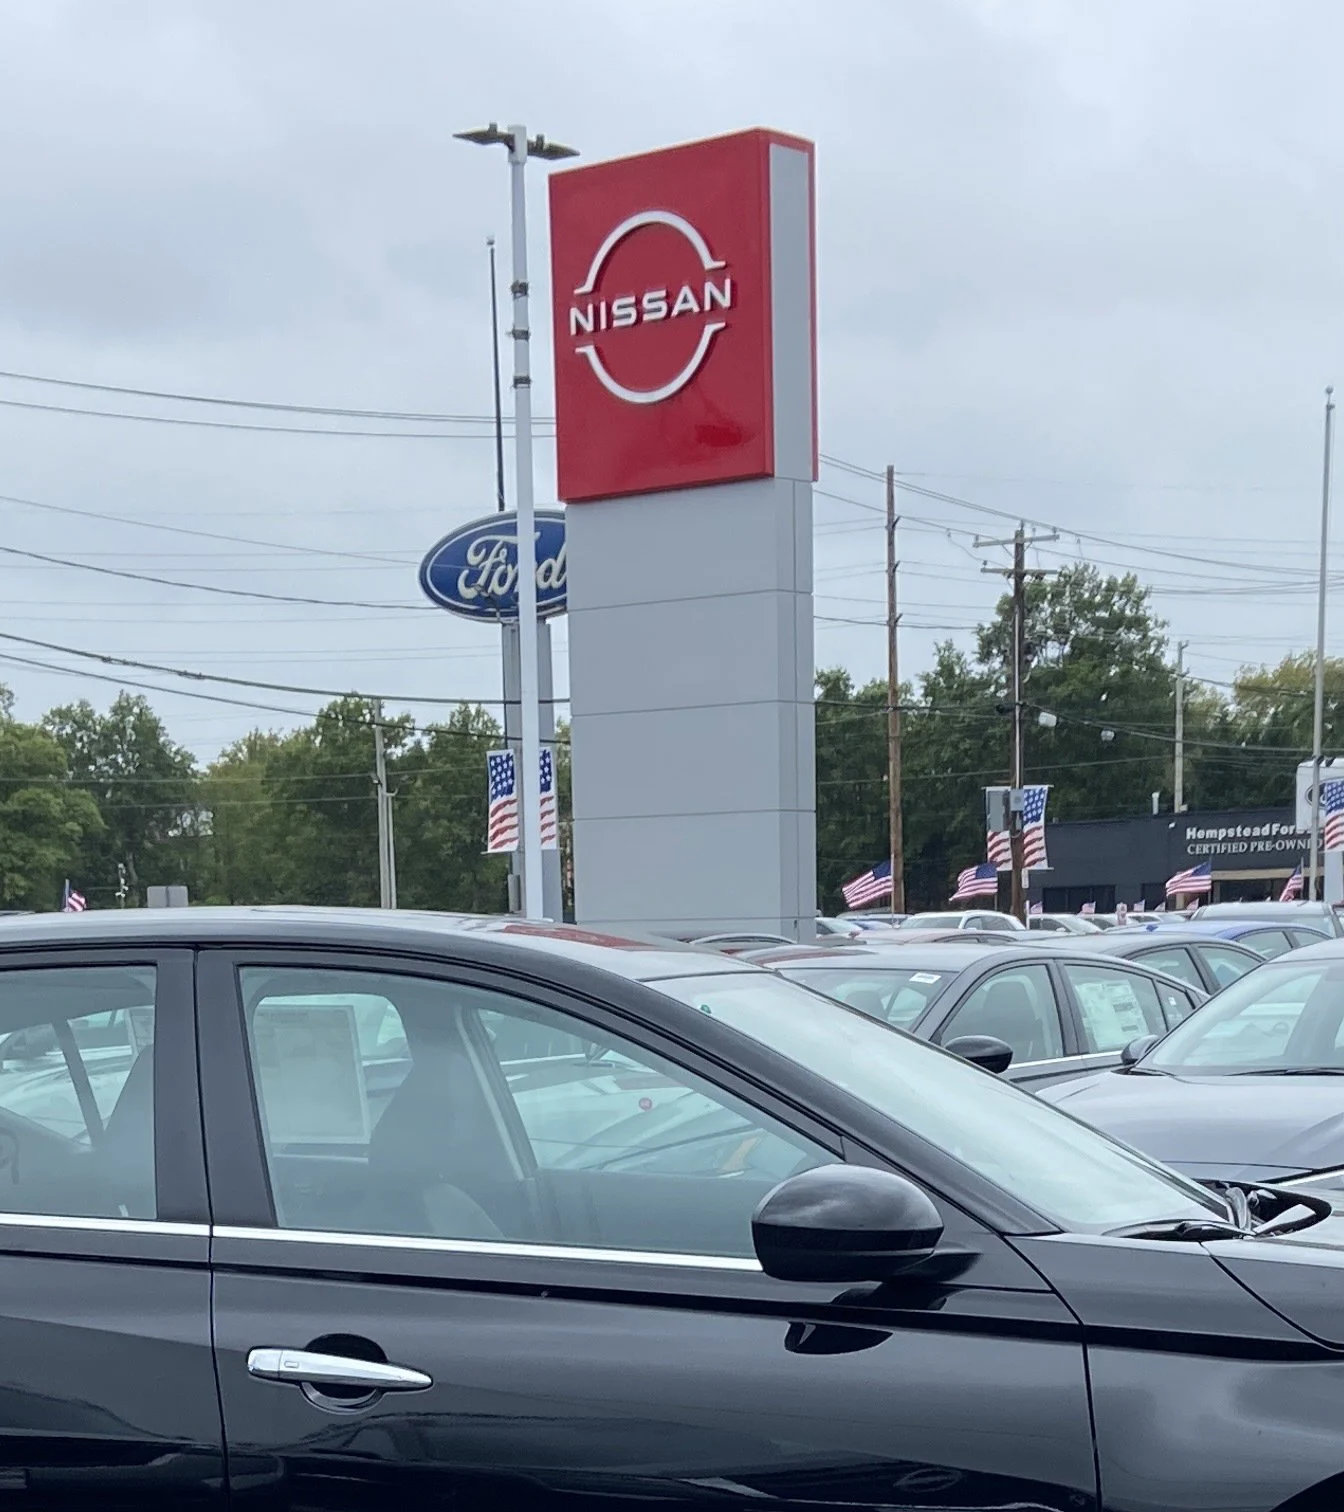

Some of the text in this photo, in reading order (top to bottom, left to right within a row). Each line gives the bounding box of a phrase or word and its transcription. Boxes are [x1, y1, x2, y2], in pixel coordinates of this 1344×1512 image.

[568, 278, 732, 336] NISSAN
[457, 531, 567, 599] Fod
[1187, 841, 1248, 855] CERTIFIED
